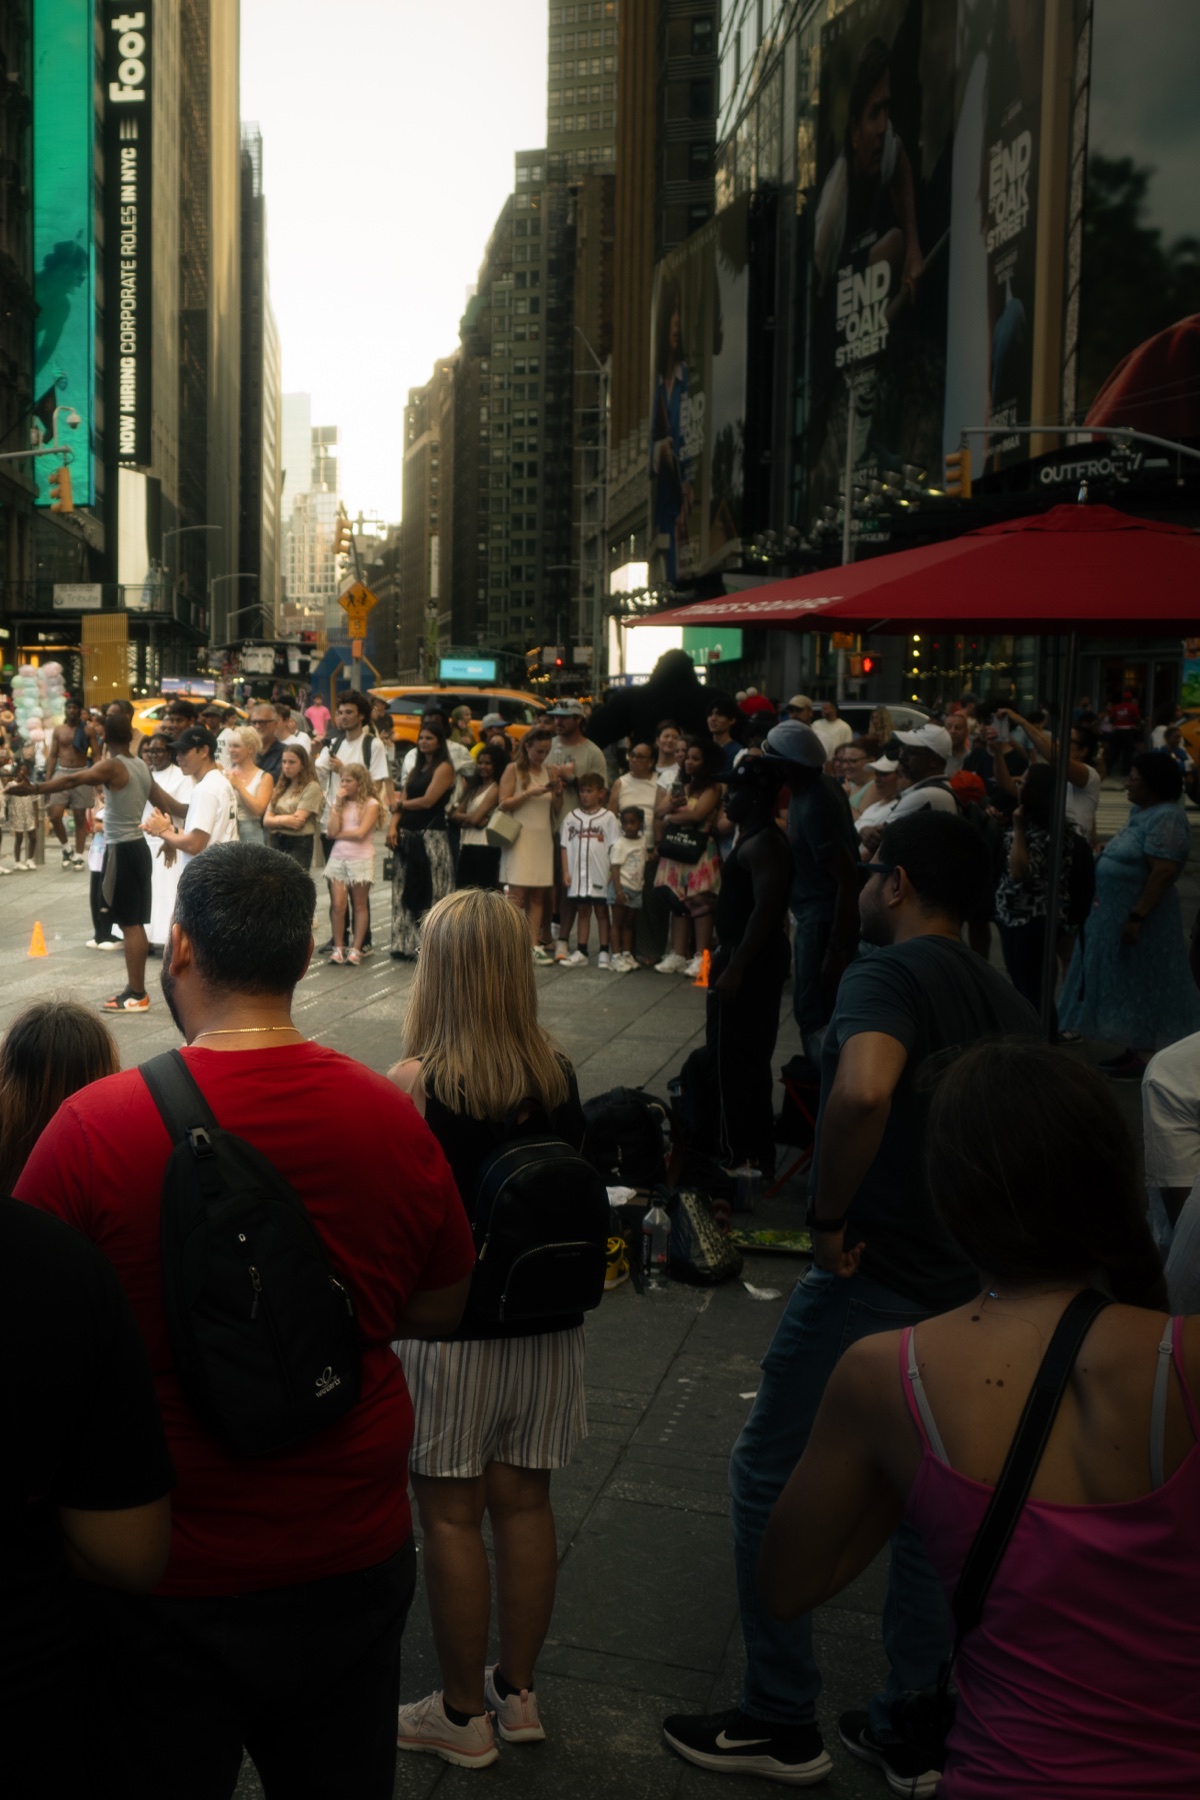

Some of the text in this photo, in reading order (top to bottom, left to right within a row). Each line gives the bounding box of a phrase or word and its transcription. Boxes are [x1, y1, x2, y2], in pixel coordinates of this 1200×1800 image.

[109, 12, 146, 102] Foot
[988, 130, 1032, 201] END
[995, 170, 1030, 224] OAK
[987, 201, 1030, 253] STREET
[120, 147, 137, 454] NOW HIRING CORPORATE ROLES IN NYC
[836, 259, 891, 319] END
[835, 326, 890, 368] STREET
[846, 297, 890, 342] OAK
